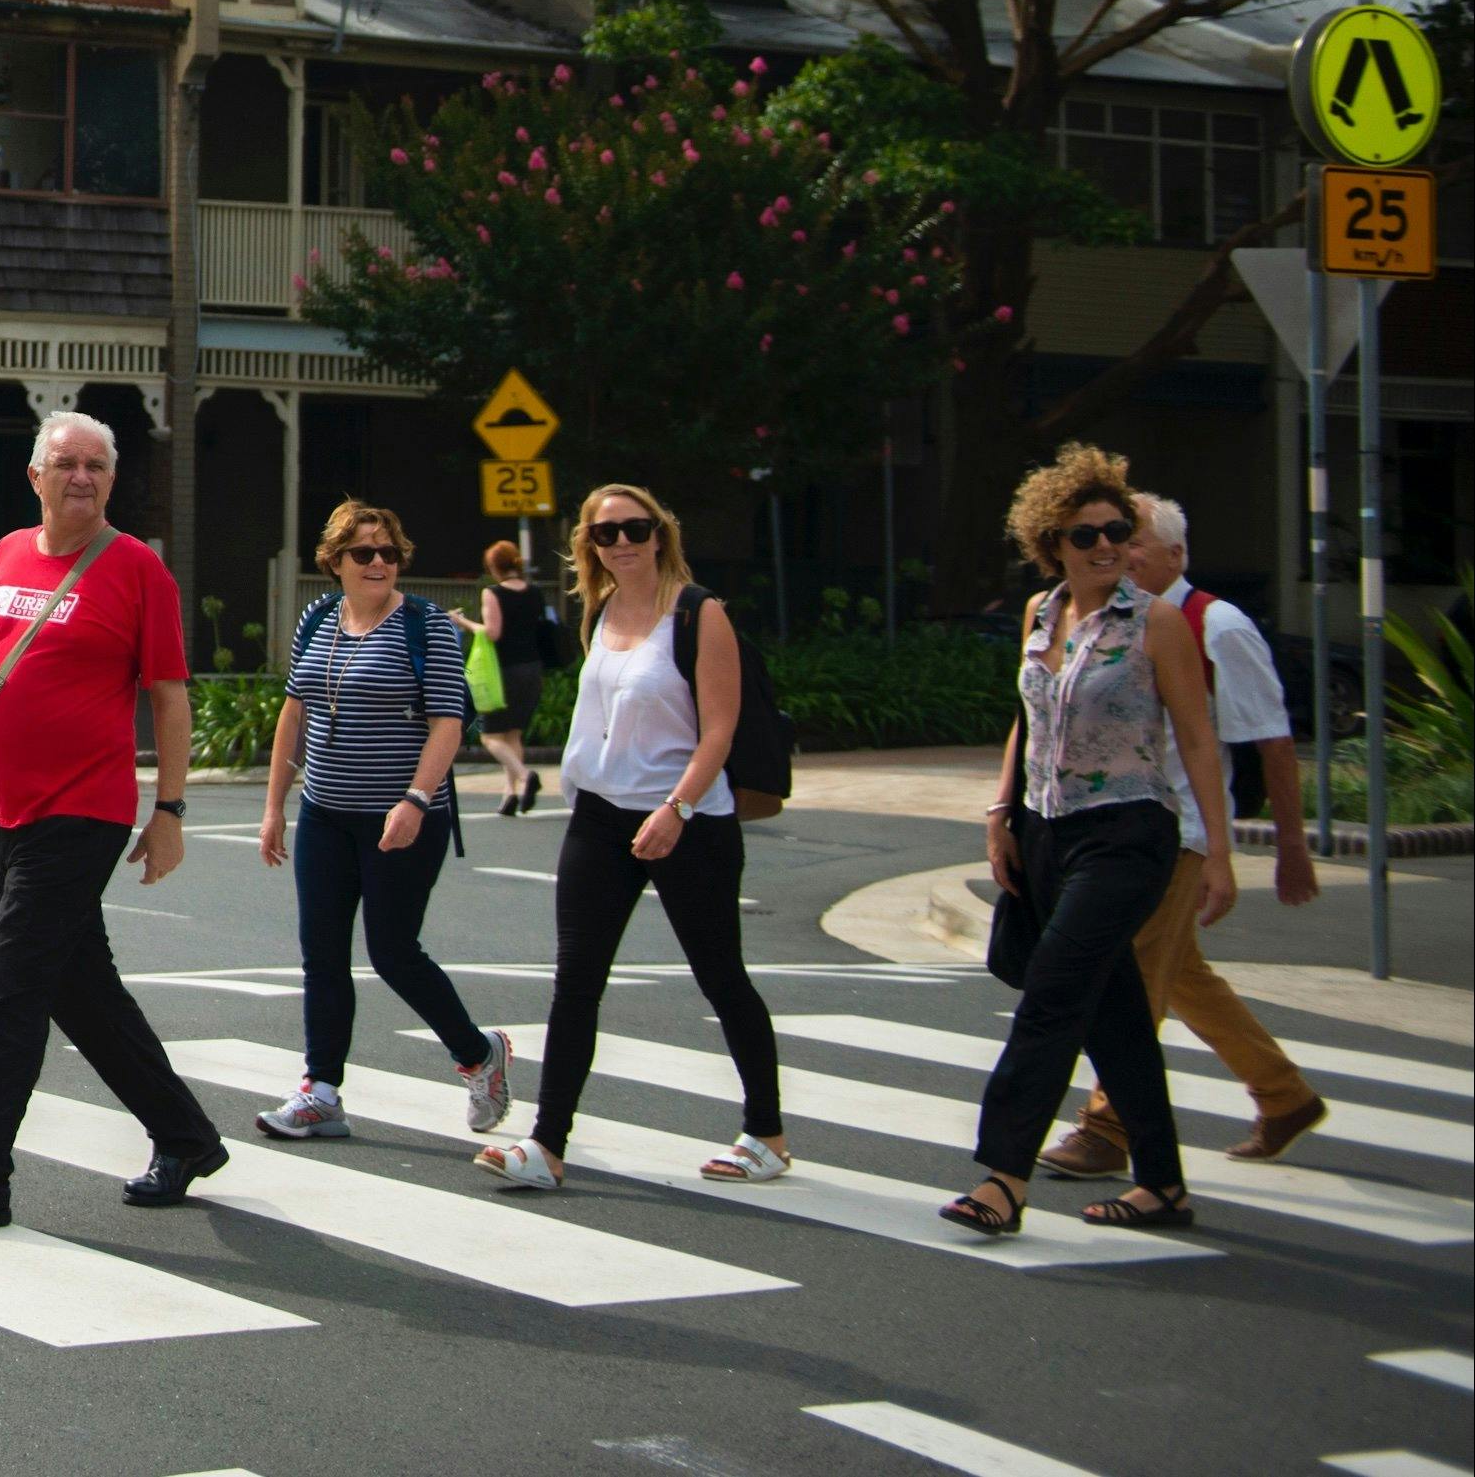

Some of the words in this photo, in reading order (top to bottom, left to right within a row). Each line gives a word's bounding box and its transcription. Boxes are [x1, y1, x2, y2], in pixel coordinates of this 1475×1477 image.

[1346, 187, 1407, 242] 25
[496, 466, 538, 494] 25
[13, 595, 72, 614] URBN
